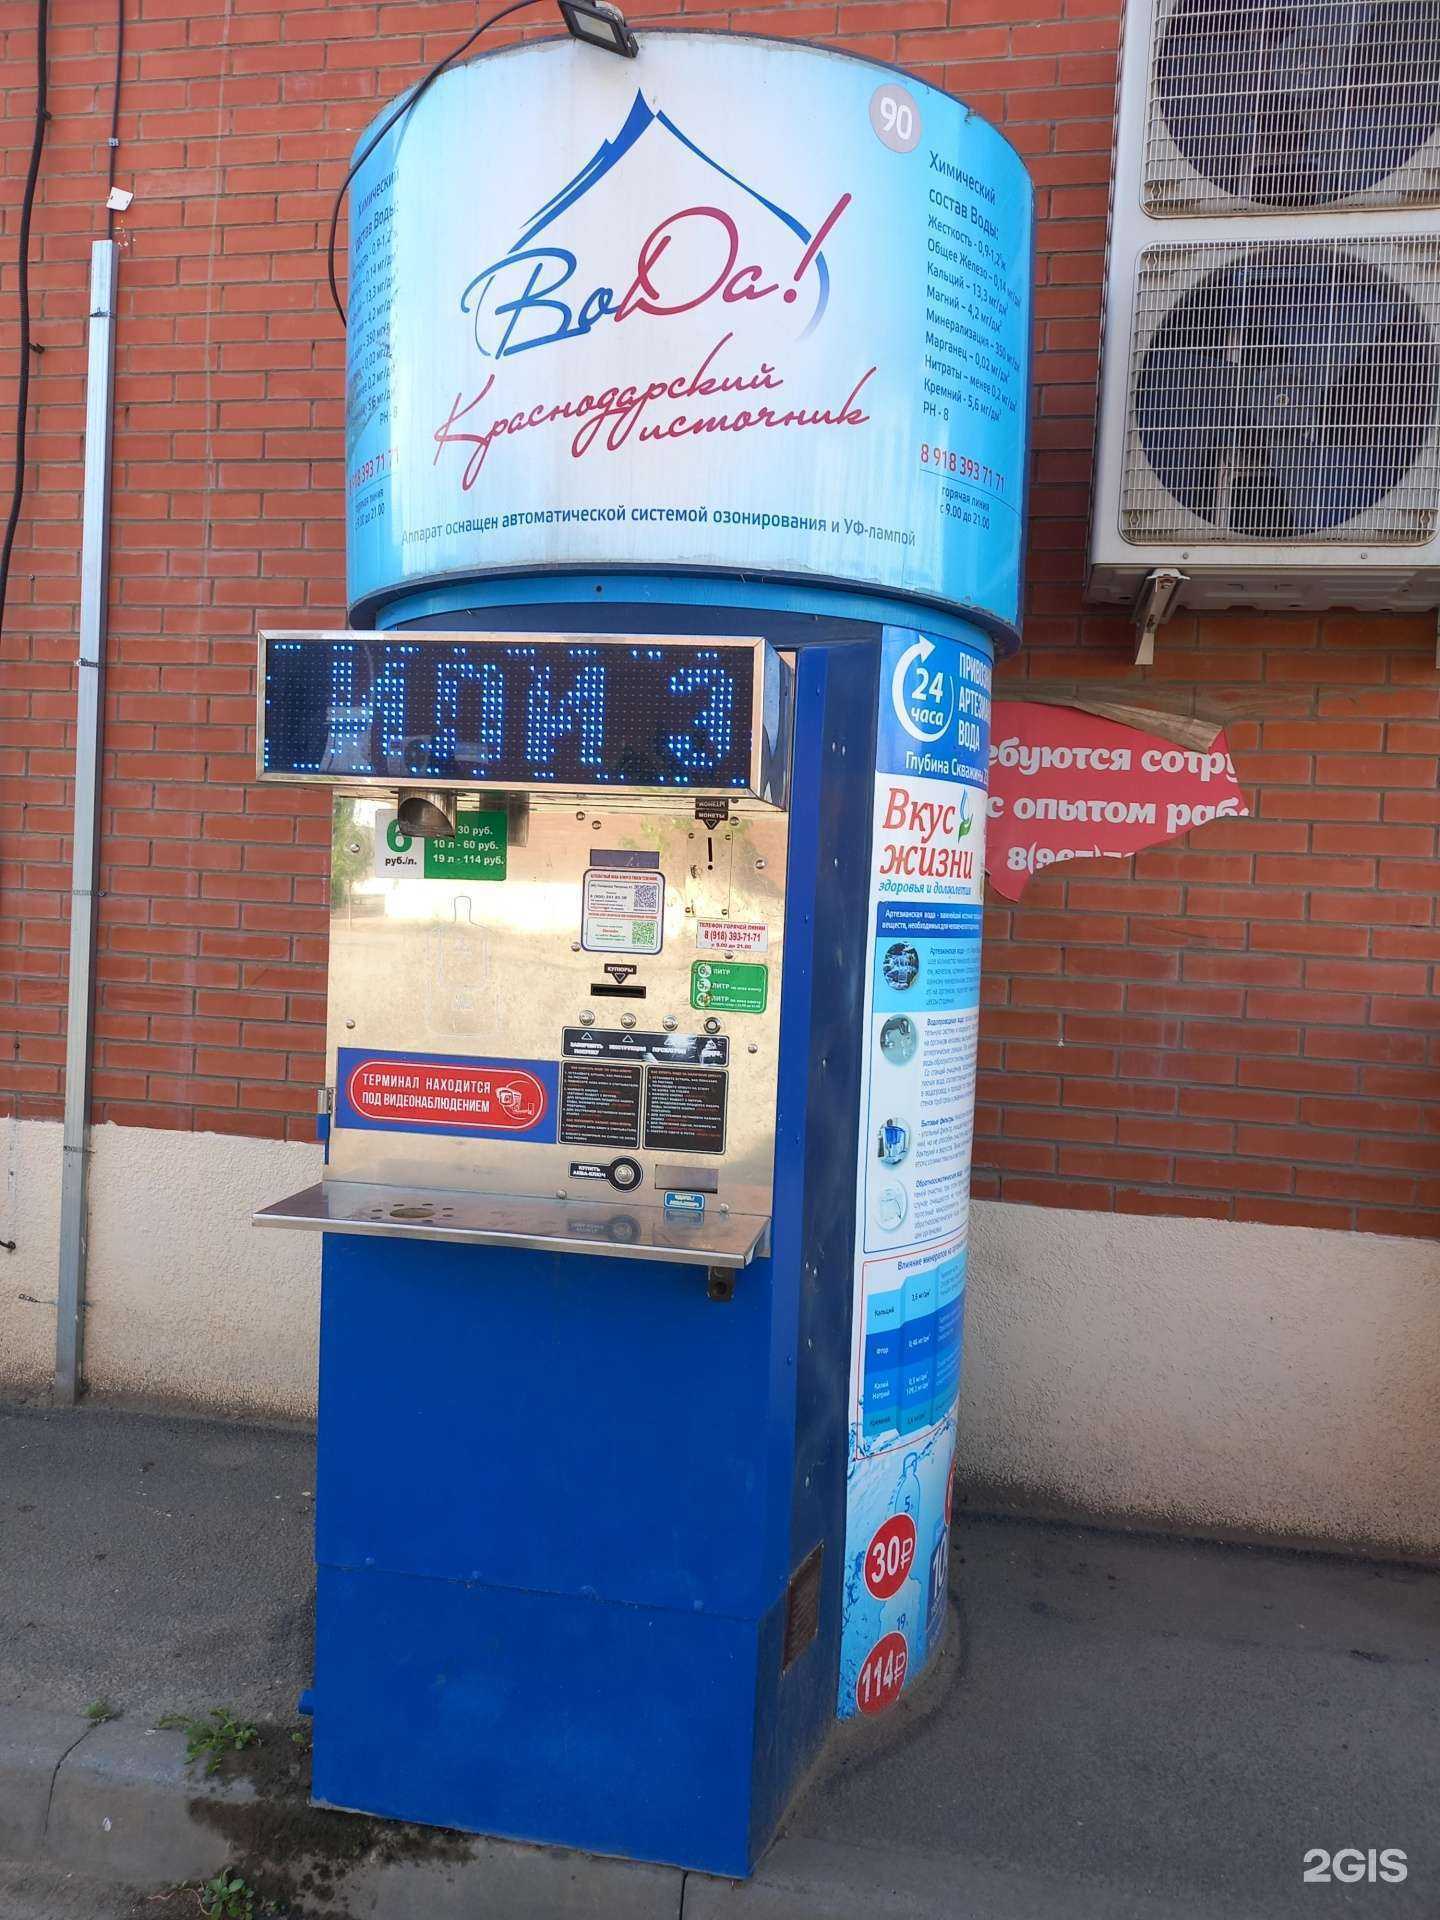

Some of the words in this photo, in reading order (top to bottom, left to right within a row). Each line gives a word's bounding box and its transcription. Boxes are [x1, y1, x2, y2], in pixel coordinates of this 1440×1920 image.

[880, 96, 913, 140] 90
[929, 150, 996, 206] Химический
[929, 188, 968, 219] состав
[970, 205, 999, 241] Воды:
[928, 213, 973, 248] Жесткость
[927, 238, 958, 263] Общее
[927, 261, 964, 290] Кальций
[926, 284, 960, 310] Магний
[926, 307, 990, 349] Минерализация
[925, 331, 968, 362] Марганец
[924, 354, 962, 381] Нитраты
[970, 375, 991, 395] менее
[638, 366, 878, 443] источник
[924, 377, 962, 403] Кремний
[967, 394, 980, 412] 5,6
[432, 332, 784, 492] Краснодарский
[943, 407, 949, 422] 8
[921, 443, 929, 464] 8
[933, 447, 957, 472] 918
[959, 456, 980, 481] 393
[982, 465, 993, 488] 71
[995, 473, 1005, 494] 71
[941, 486, 970, 504] горячая
[971, 497, 990, 513] линия
[400, 523, 443, 547] Аппарат
[445, 514, 499, 536] оснащен
[501, 505, 626, 529] автоматической
[631, 505, 708, 523] системой
[712, 508, 827, 532] озонирования
[831, 520, 840, 534] и
[843, 517, 917, 547] УФ-лампой
[945, 503, 962, 519] 9.00
[963, 512, 972, 524] до
[972, 512, 990, 531] 21.00
[911, 666, 944, 704] 24
[911, 706, 944, 727] часа
[958, 720, 981, 752] ВОДА
[905, 750, 949, 774] Глубина
[882, 787, 956, 844] Вкус
[986, 797, 1005, 819] с
[1013, 798, 1156, 825] опытом
[386, 818, 413, 853] 6
[457, 825, 470, 836] 30
[472, 825, 494, 837] руб.
[433, 839, 447, 849] 10
[450, 840, 455, 850] л
[463, 840, 476, 850] 60
[478, 840, 500, 852] руб.
[385, 856, 417, 867] руб./л.
[433, 854, 445, 864] 19
[450, 855, 455, 864] л
[464, 855, 481, 864] 114
[483, 855, 505, 866] руб.
[878, 878, 925, 896] здоровья
[926, 882, 932, 892] и
[885, 909, 923, 920] Артезианская
[924, 911, 936, 919] вода
[704, 930, 709, 940] 8
[710, 930, 728, 942] (918)
[729, 931, 761, 942] 393-71-71
[713, 967, 731, 976] ЛИТР
[711, 995, 730, 1003] ЛИТР
[712, 982, 730, 990] ЛИТР
[362, 1073, 420, 1089] ТЕРМИНАЛ
[425, 1076, 491, 1095] НАХОДИТСЯ
[362, 1091, 382, 1106] ПОД
[383, 1094, 490, 1114] ВИДЕОНАБЛЮДЕНИЕМ
